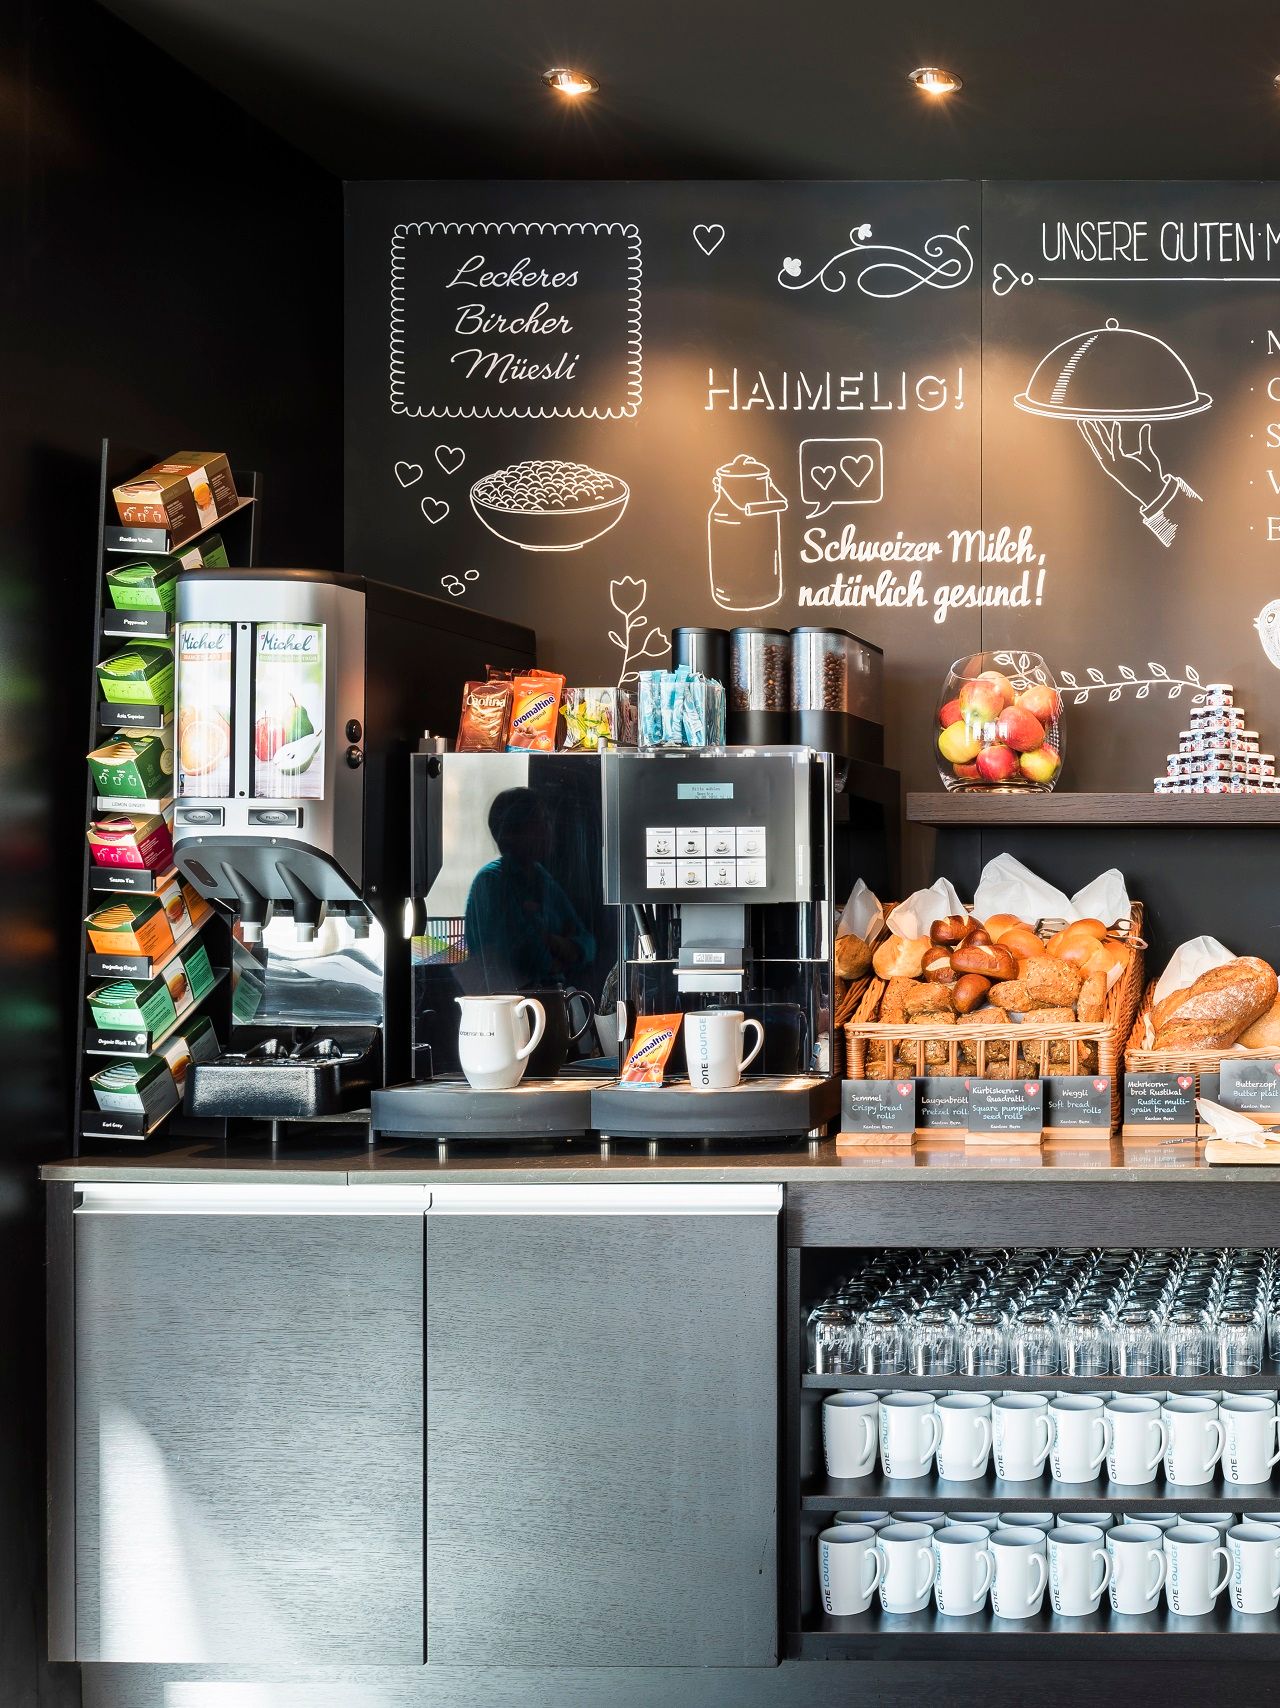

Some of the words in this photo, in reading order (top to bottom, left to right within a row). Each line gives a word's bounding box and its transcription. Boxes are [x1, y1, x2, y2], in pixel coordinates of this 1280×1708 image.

[1043, 221, 1148, 261] UNSERE
[1161, 222, 1254, 262] GUTEN
[446, 255, 578, 288] Leckeres
[455, 302, 573, 334] Bircher
[451, 349, 579, 383] Müesli
[705, 368, 963, 411] HAIMELIG!
[800, 524, 942, 563] Schweizer
[947, 526, 1045, 565] Milch,
[798, 570, 928, 607] natürlich
[934, 569, 1045, 623] gesund!
[181, 631, 225, 651] Michel
[261, 630, 313, 652] Michel
[513, 696, 555, 728] ovomaltine
[700, 1017, 708, 1061] LOUNGE
[701, 1063, 710, 1085] ONE
[1127, 1080, 1169, 1089] Mehrkorn-
[1235, 1080, 1277, 1089] Butterzopf
[851, 1094, 882, 1102] Semmel
[972, 1086, 1019, 1095] Kürbiskern-
[986, 1095, 1025, 1103] Quadratli
[1062, 1089, 1089, 1099] Weggli
[1130, 1087, 1147, 1096] brot
[1149, 1088, 1182, 1096] Rustikal
[1233, 1089, 1257, 1097] Butter
[1260, 1090, 1279, 1100] plait
[851, 1104, 877, 1115] Crispy
[879, 1103, 903, 1112] bread
[972, 1105, 998, 1114] Square
[1001, 1105, 1041, 1115] pumpkin-
[1048, 1100, 1064, 1109] Soft
[1067, 1100, 1090, 1108] bread
[1130, 1106, 1151, 1115] grain
[1154, 1105, 1177, 1113] bread
[876, 1112, 896, 1120] rolls
[1004, 1112, 1024, 1120] rolls
[1231, 1458, 1239, 1480] ONE
[822, 1544, 830, 1587] LOUNGE
[1171, 1544, 1179, 1588] LOUNGE
[1234, 1541, 1242, 1586] LOUNGE
[825, 1588, 833, 1612] ONE
[937, 1589, 945, 1610] ONE
[1172, 1589, 1180, 1611] ONE
